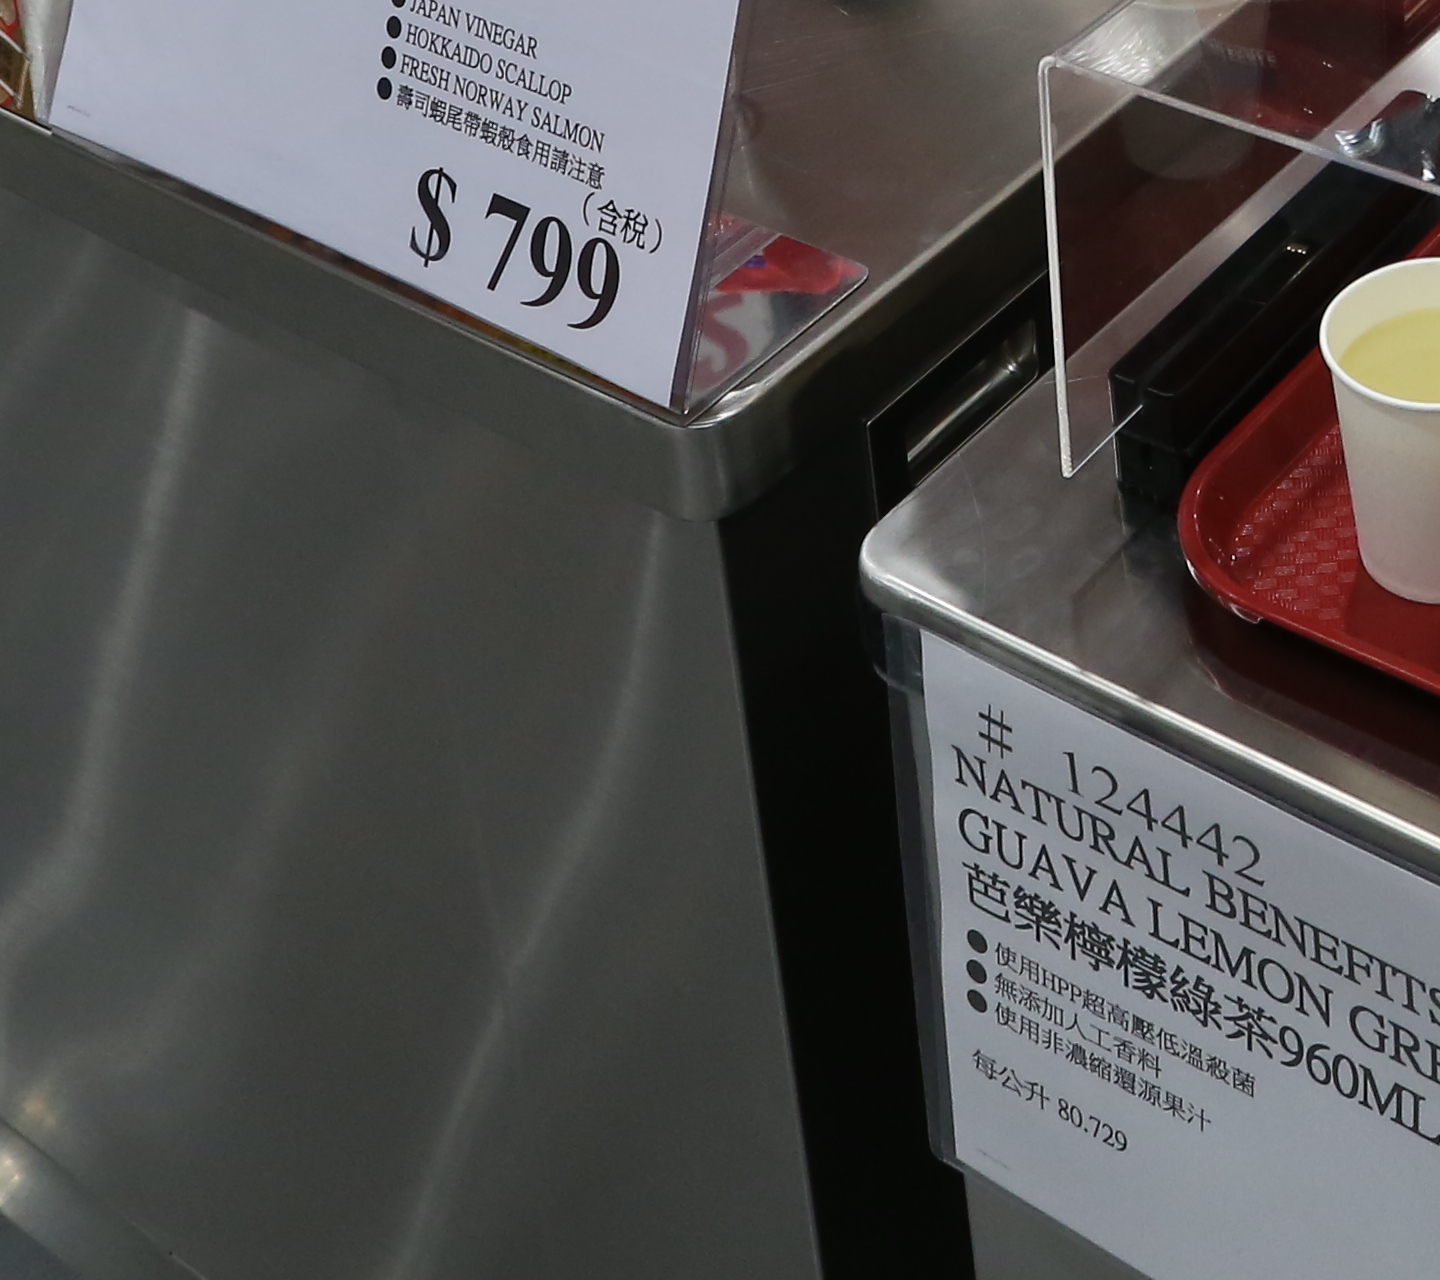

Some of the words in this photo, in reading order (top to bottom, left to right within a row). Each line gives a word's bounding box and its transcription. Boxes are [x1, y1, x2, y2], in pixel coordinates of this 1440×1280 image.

[405, 22, 493, 76] HOKKAIDO
[495, 58, 573, 106] SCALLOP
[464, 11, 539, 60] VINEGAR
[395, 83, 606, 191] 壽司蝦尾帶蝦殼食用請注意
[399, 53, 451, 92] FRESH
[453, 73, 529, 123] NORWAY
[531, 105, 606, 154] SALMON
[409, 167, 458, 269] $
[483, 192, 622, 332] 799
[950, 743, 1192, 897] NATURAL
[978, 703, 1013, 759] #
[1062, 750, 1267, 888] 124442
[958, 806, 1134, 927] GUAVA
[1147, 897, 1332, 1028] LEMON
[993, 939, 1257, 1099] 使用HPP超高壓低溫殺菌
[993, 972, 1163, 1081] 無添加人工香料
[971, 1048, 1051, 1116] 每公升
[1056, 1094, 1129, 1154] 80.729
